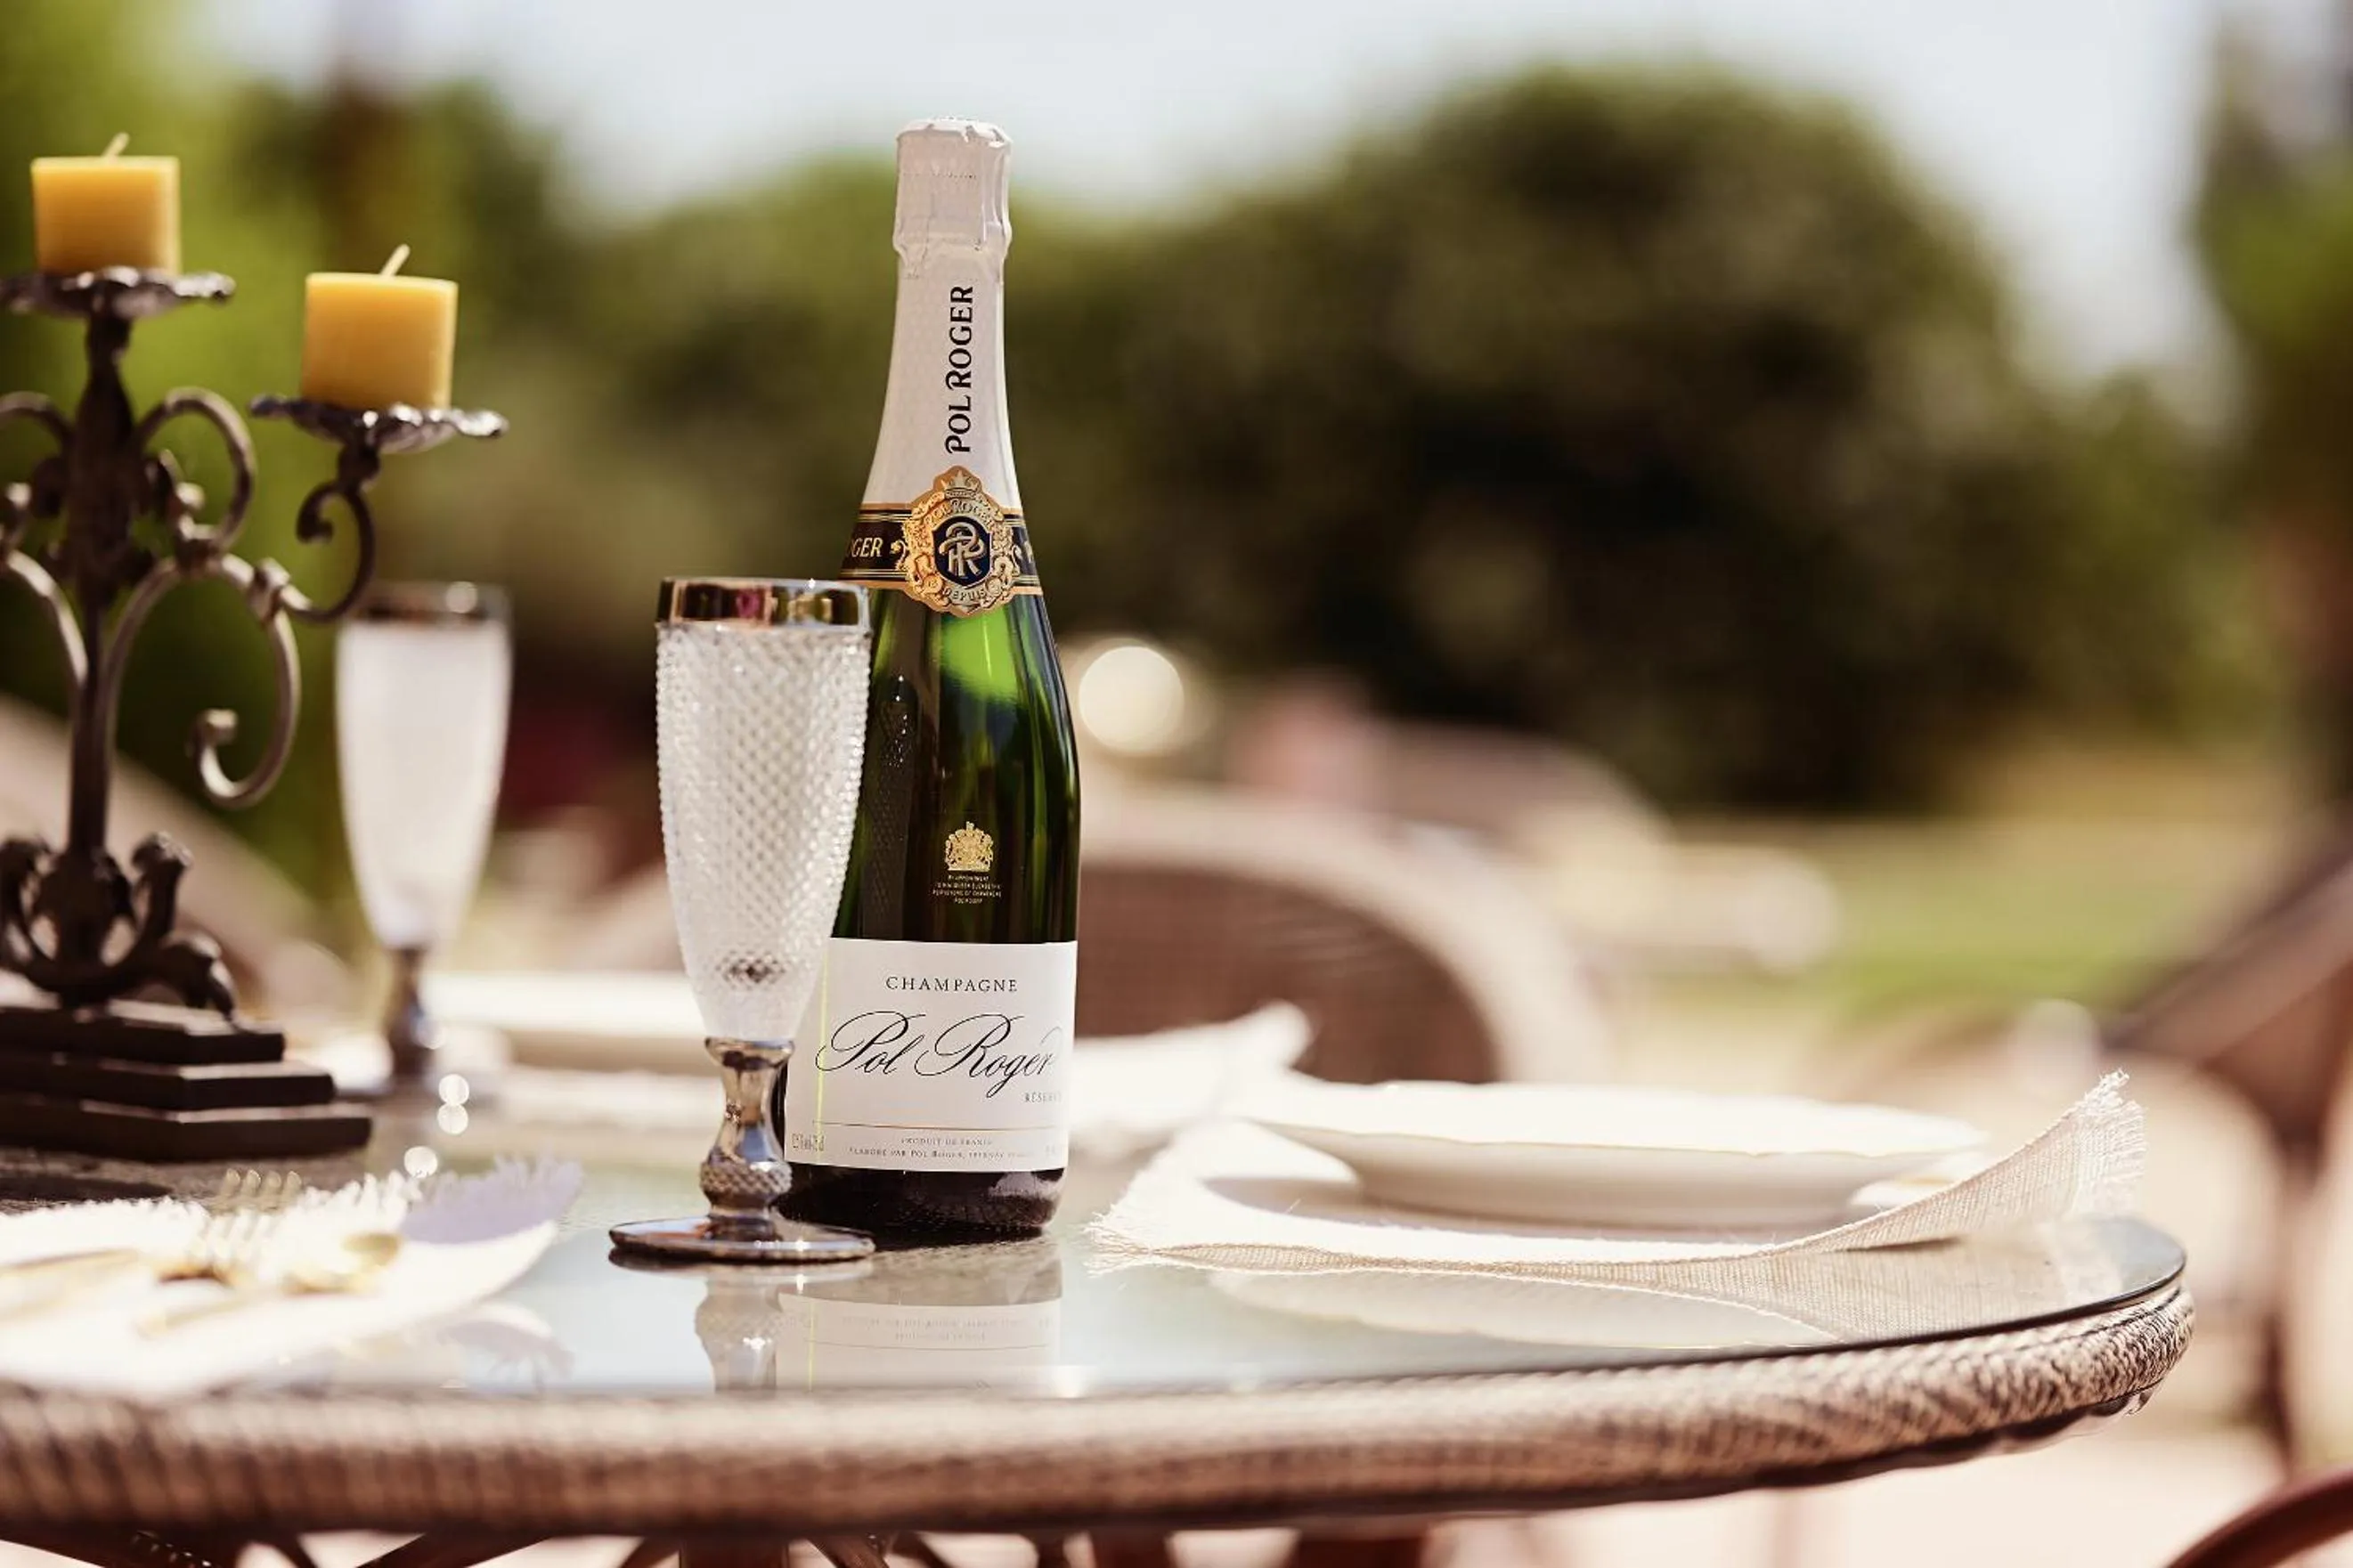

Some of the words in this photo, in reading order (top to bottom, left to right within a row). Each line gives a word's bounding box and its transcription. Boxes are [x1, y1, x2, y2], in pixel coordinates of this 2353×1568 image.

[945, 286, 973, 392] ROGER
[944, 394, 971, 455] POL
[942, 587, 987, 602] DEPUIS
[885, 976, 1018, 993] CHAMPAGNE
[815, 1011, 927, 1076] Pol
[914, 1013, 1063, 1099] Roger
[910, 1149, 927, 1158] POL
